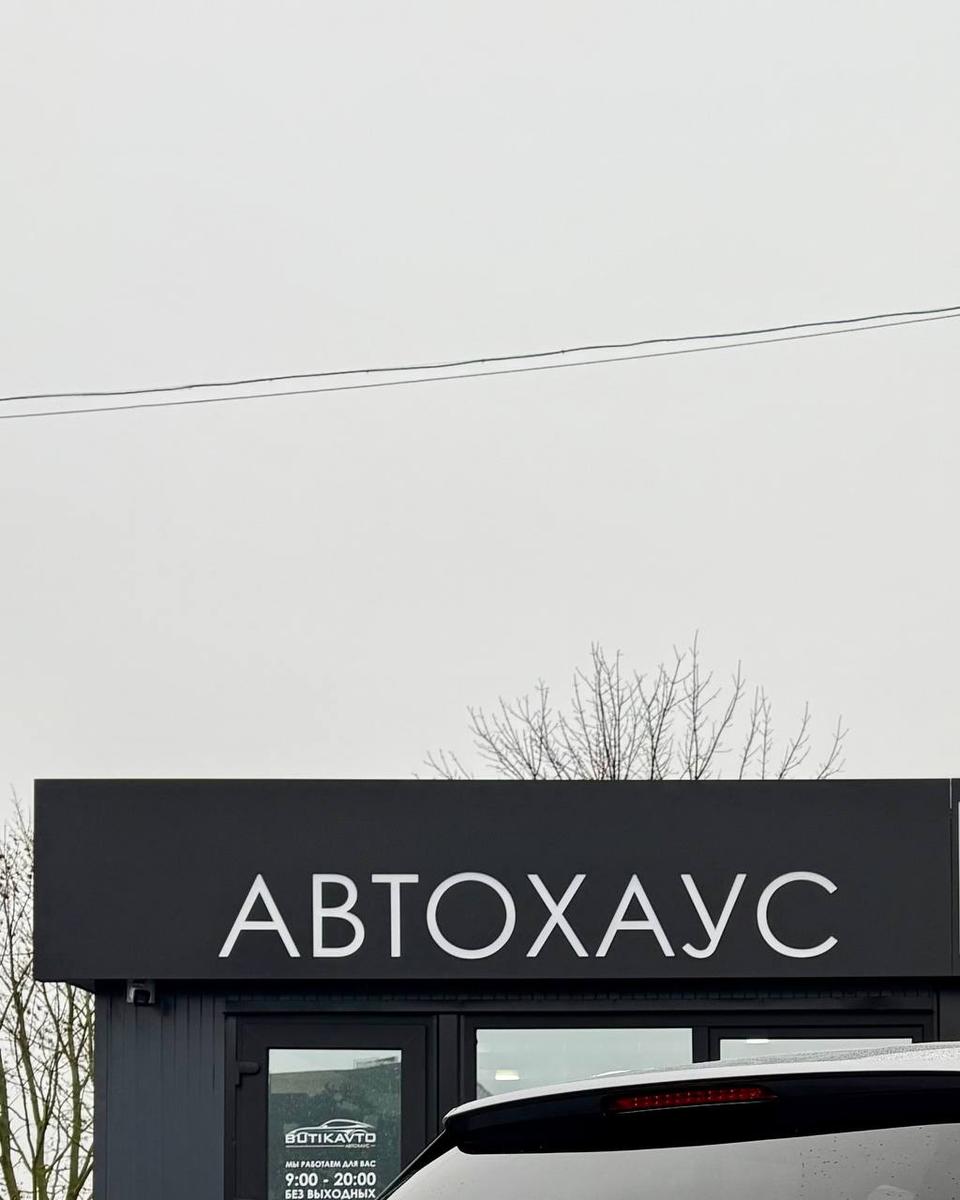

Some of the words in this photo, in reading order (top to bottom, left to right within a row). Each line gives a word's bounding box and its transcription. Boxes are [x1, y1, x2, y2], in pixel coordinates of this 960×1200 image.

[219, 871, 838, 960] АВТОХАУС
[285, 1132, 377, 1144] BUTIKAVTO
[301, 1160, 341, 1168] РАБОТАЕМ
[342, 1160, 358, 1168] ДЛЯ
[360, 1160, 376, 1168] ВАС
[285, 1172, 318, 1186] 9:00
[333, 1172, 376, 1186] 20:00
[285, 1189, 304, 1199] БЕЗ
[307, 1188, 376, 1199] ВЫХОДНЫХ
